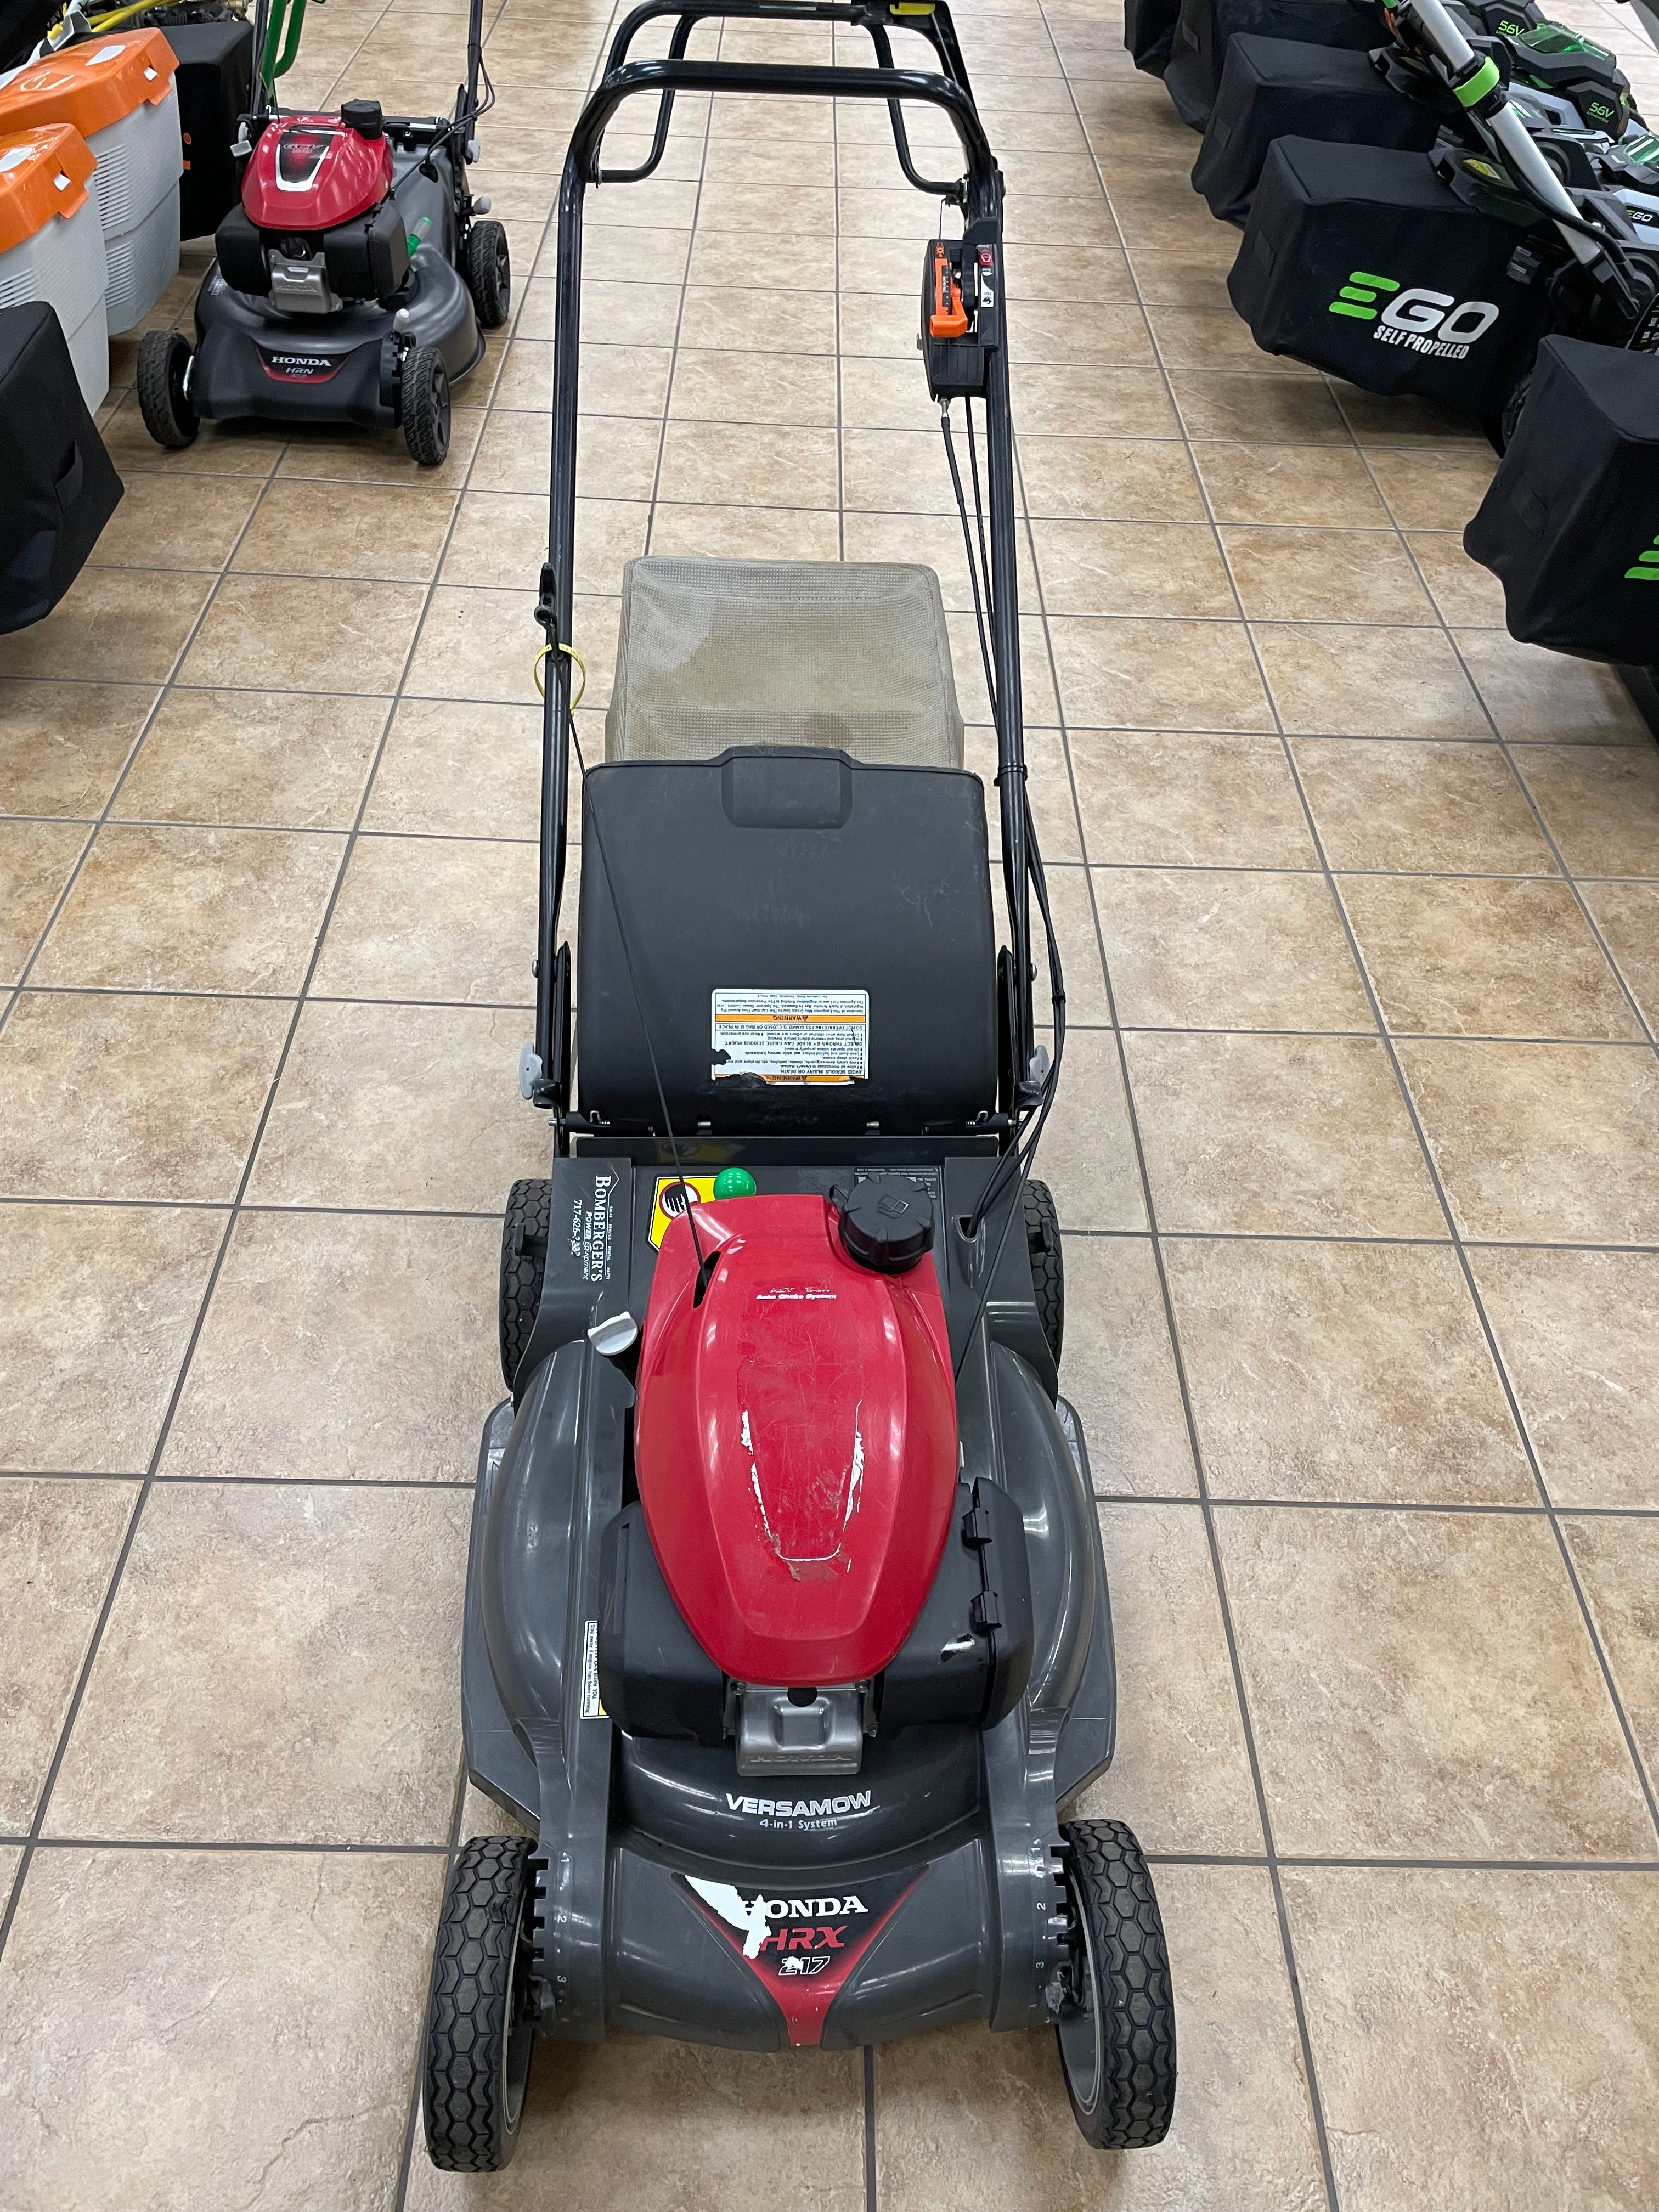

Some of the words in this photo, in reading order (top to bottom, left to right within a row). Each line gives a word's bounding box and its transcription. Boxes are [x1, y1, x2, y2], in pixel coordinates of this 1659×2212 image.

[1499, 20, 1525, 36] 56V
[1589, 102, 1615, 119] 56V
[1627, 209, 1654, 222] EGO
[1329, 271, 1499, 343] EGO
[1373, 325, 1407, 345] SELF
[1404, 334, 1469, 359] PROPELLED
[271, 357, 332, 366] HONDA
[591, 1176, 611, 1282] BOMBERGER'S
[726, 1790, 871, 1816] VERSAMOW
[759, 1819, 793, 1829] 4-in-1
[798, 1819, 837, 1831] System
[557, 1915, 567, 1923] 2
[760, 1926, 847, 1951] HRX
[1035, 1961, 1045, 1969] 3
